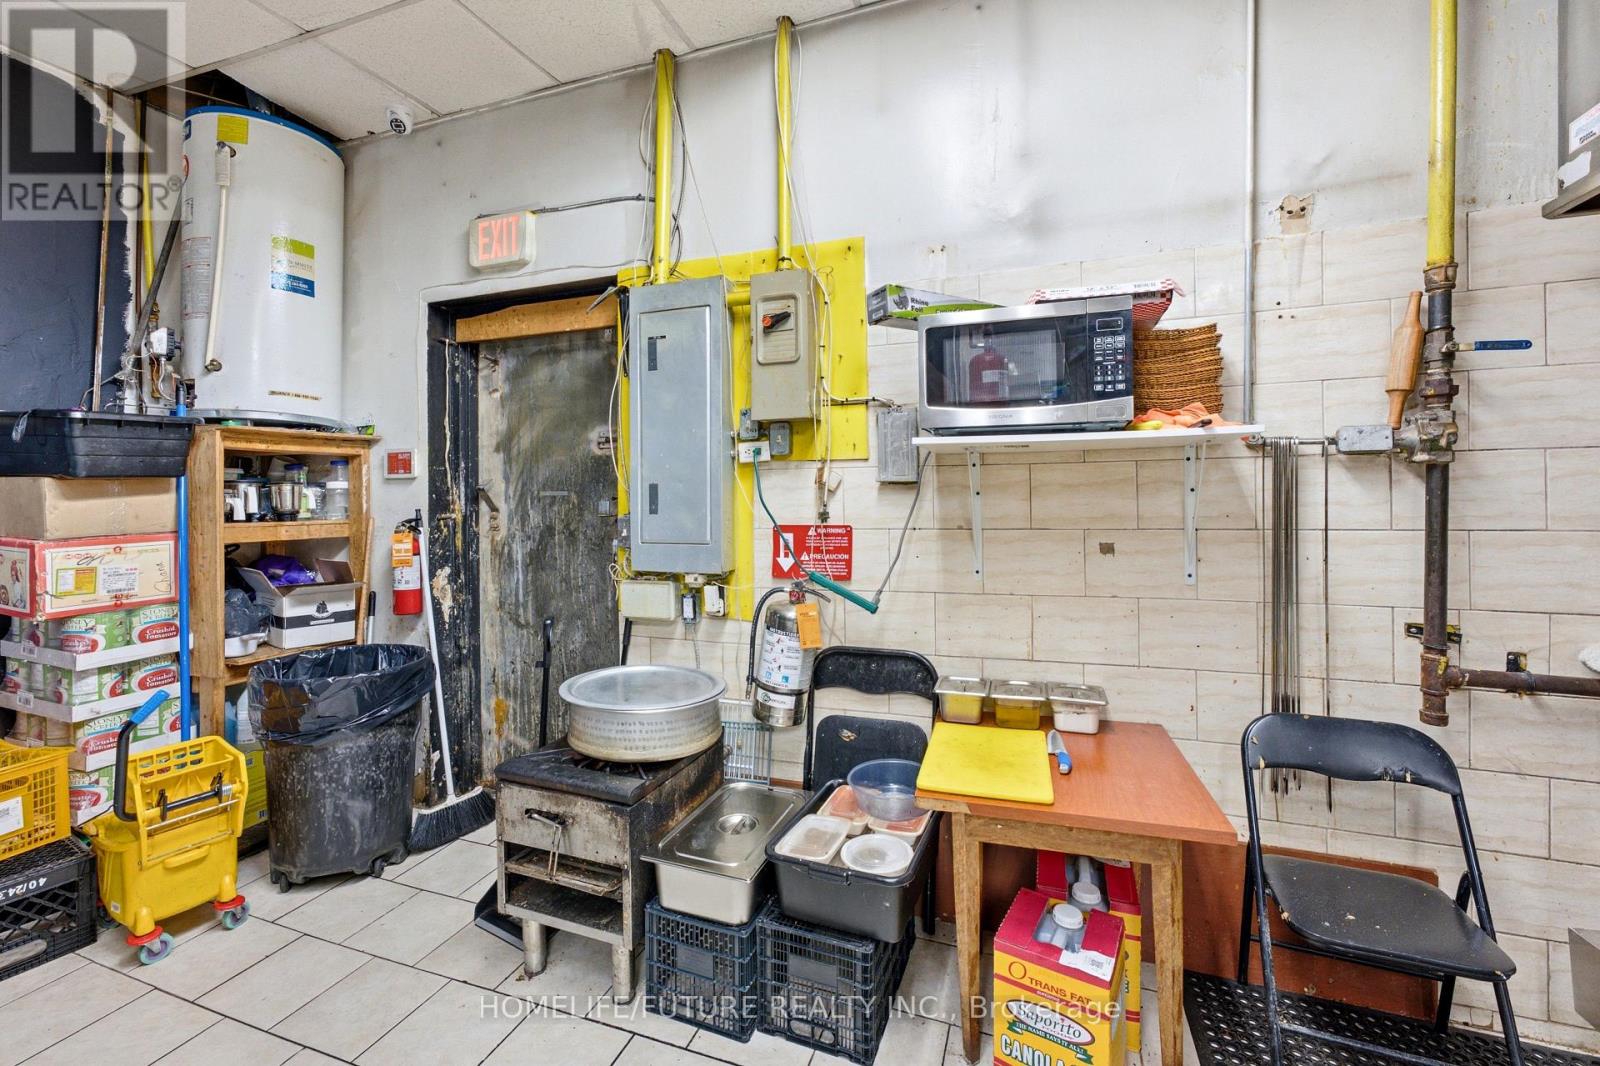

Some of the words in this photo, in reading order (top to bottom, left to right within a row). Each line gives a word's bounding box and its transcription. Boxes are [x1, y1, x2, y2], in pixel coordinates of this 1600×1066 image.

[478, 216, 520, 261] EXIT
[816, 526, 847, 535] WARNING
[1027, 976, 1067, 997] TRANS
[1070, 992, 1093, 1006] FAT
[1017, 1004, 1082, 1039] Saporito
